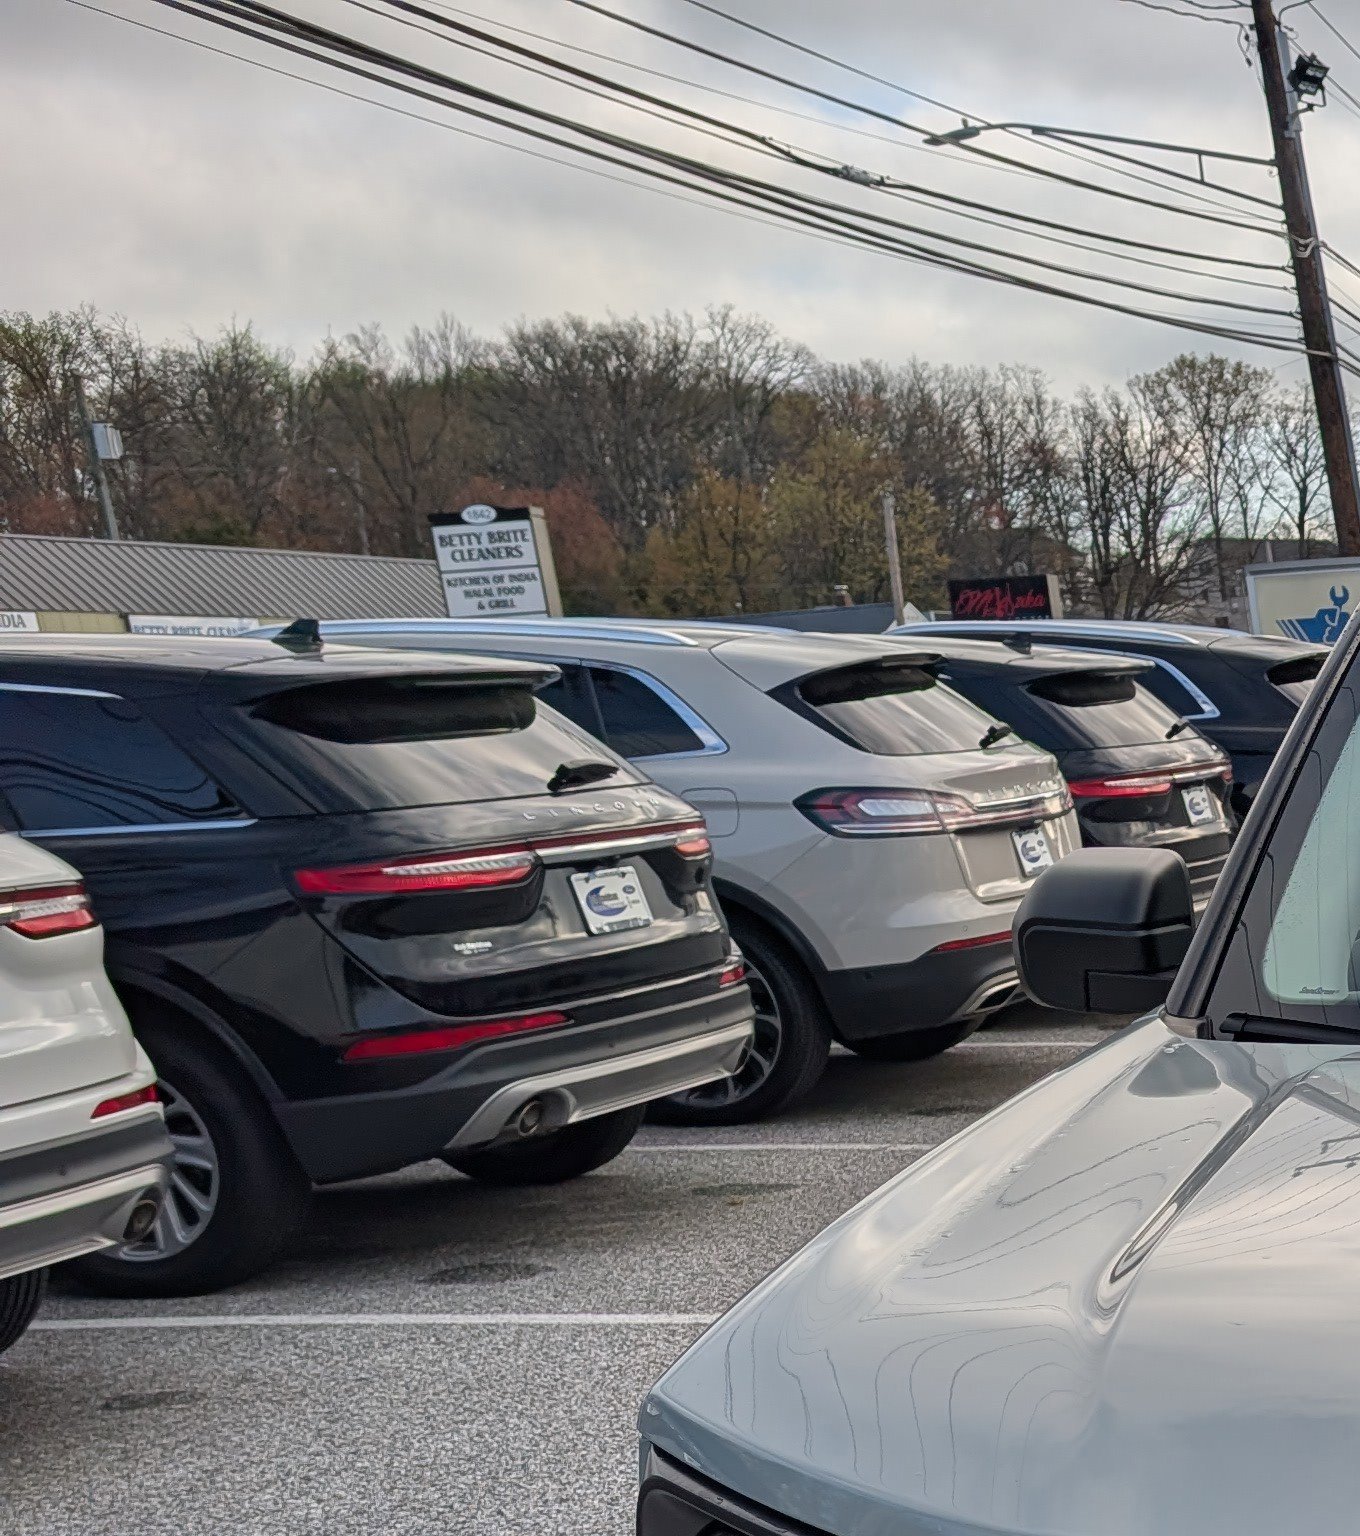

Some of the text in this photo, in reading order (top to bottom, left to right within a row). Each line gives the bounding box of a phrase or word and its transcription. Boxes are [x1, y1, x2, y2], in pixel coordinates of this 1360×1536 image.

[438, 528, 529, 548] BETTY BRITE
[450, 545, 523, 563] CLEANERS
[497, 585, 525, 596] FOOD
[0, 613, 27, 628] DIA
[523, 797, 659, 821] LINCOLN
